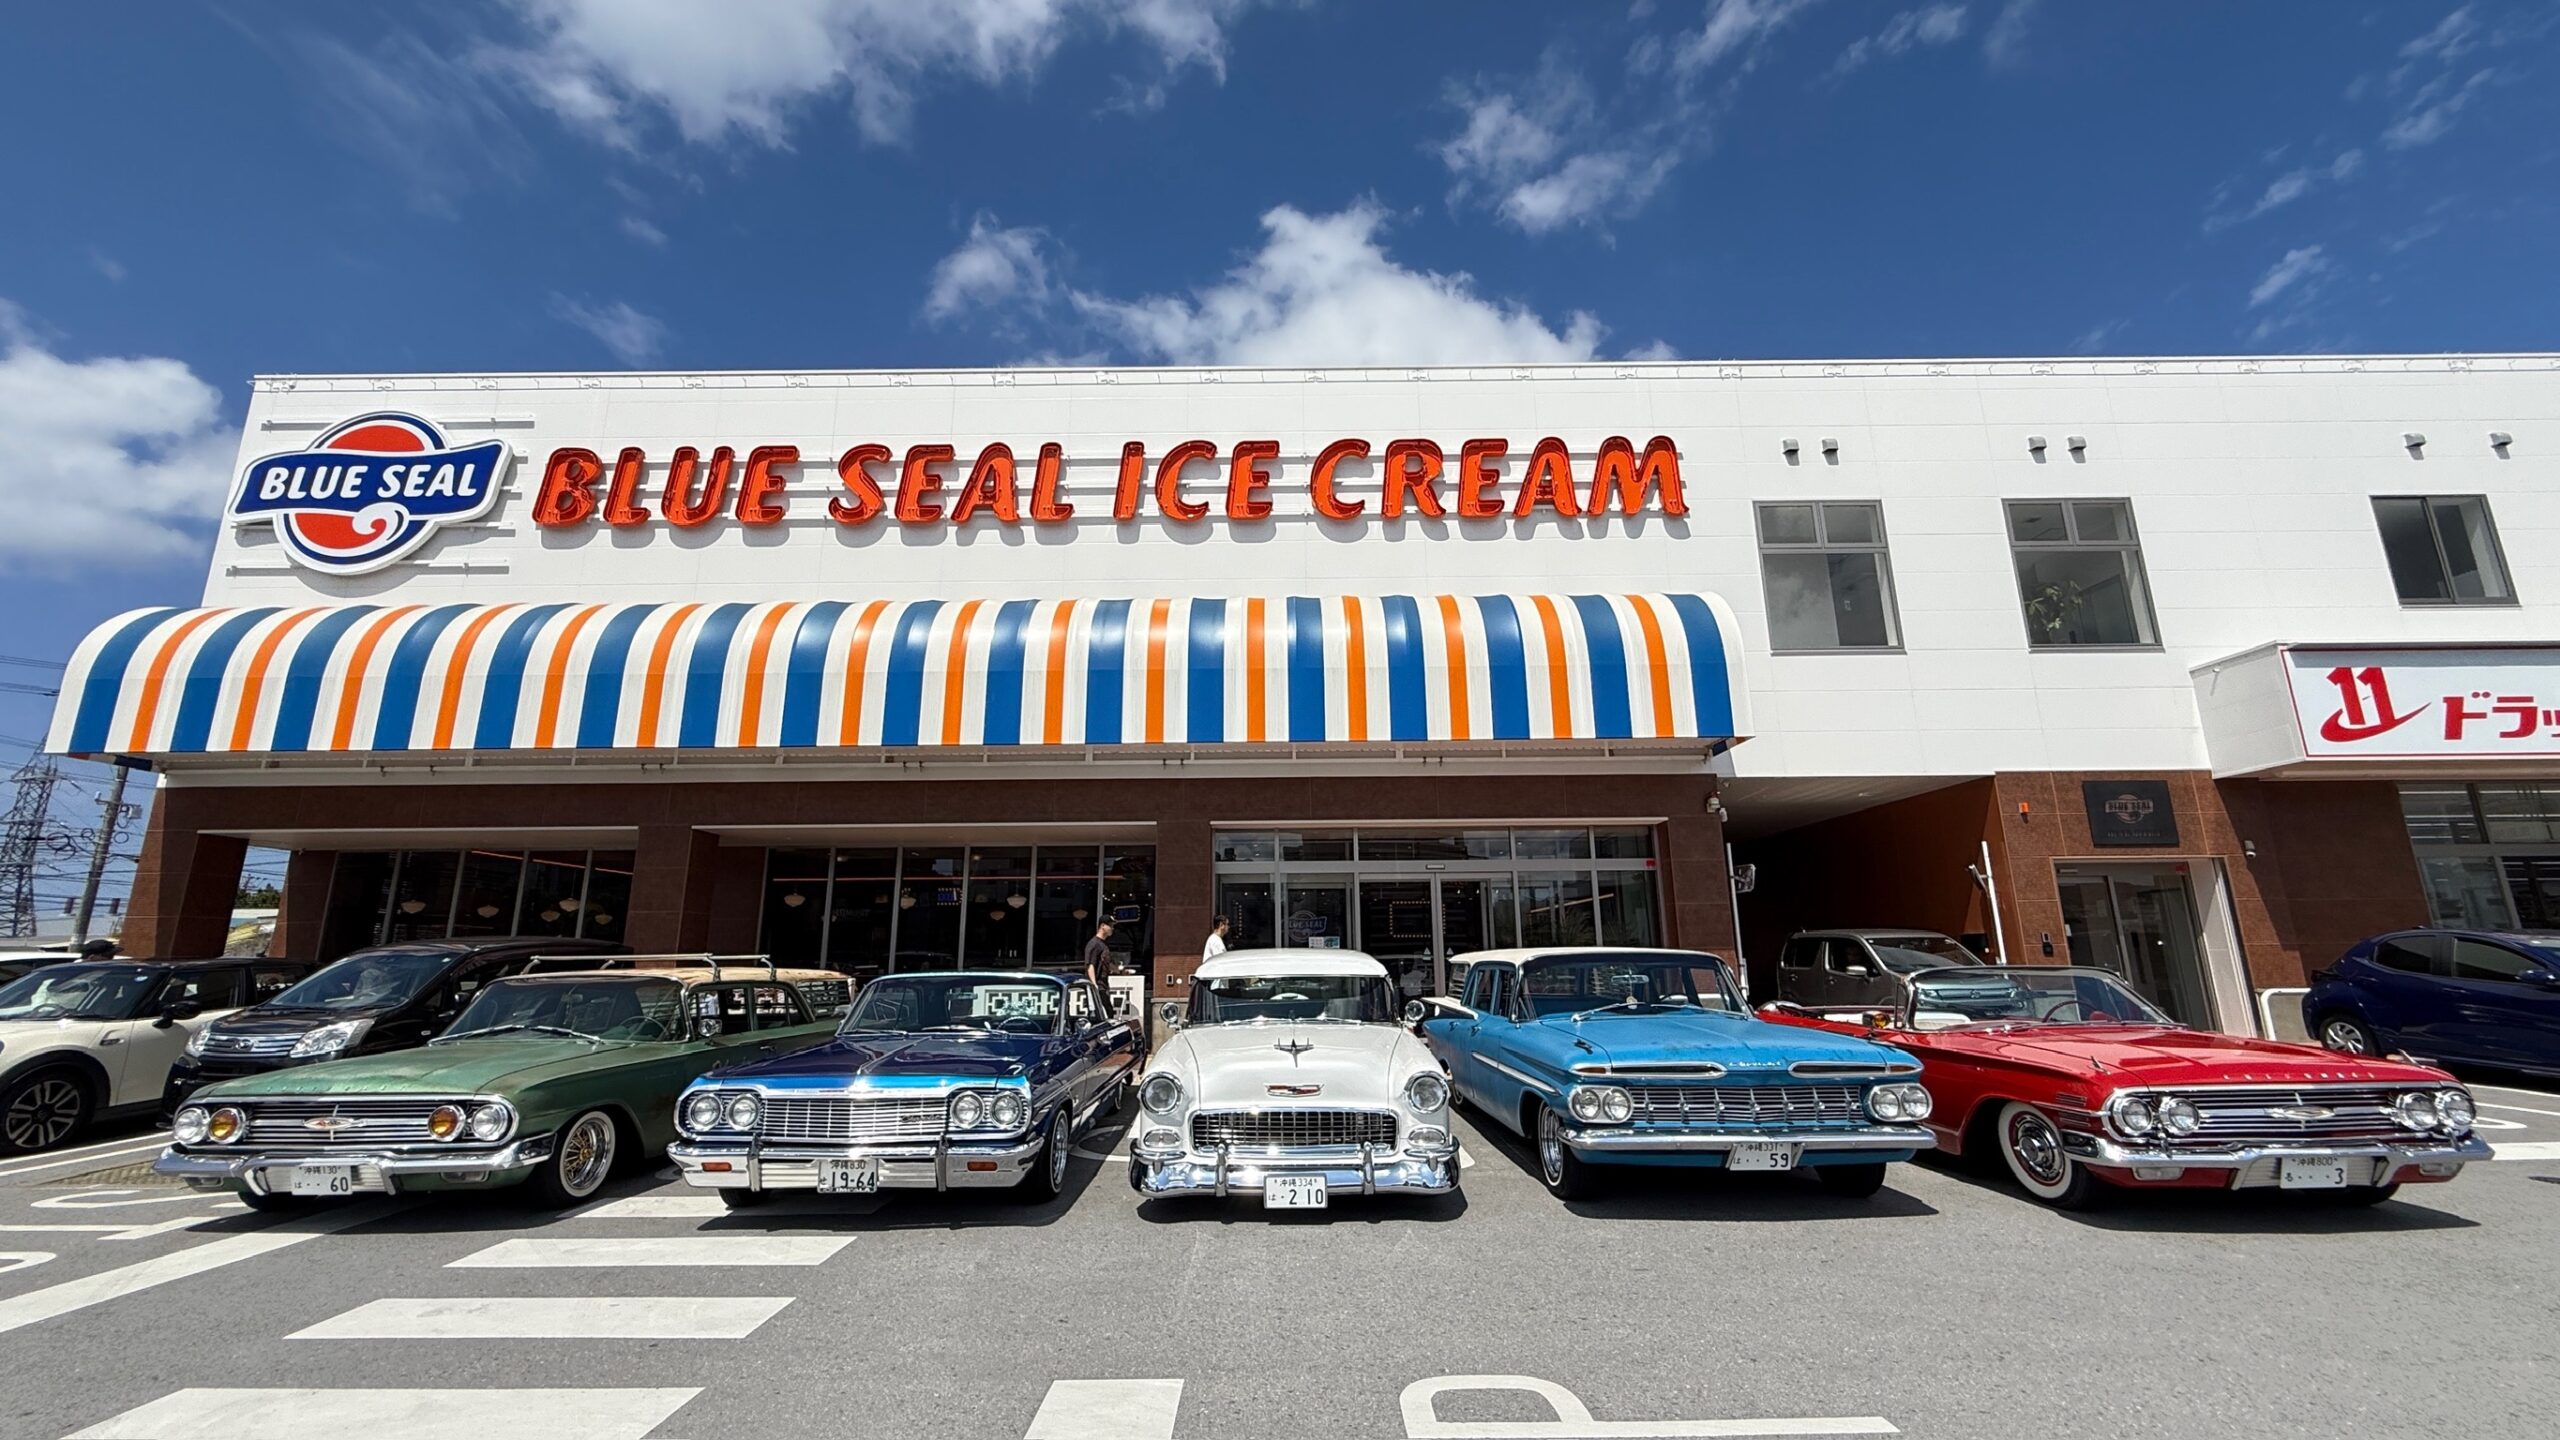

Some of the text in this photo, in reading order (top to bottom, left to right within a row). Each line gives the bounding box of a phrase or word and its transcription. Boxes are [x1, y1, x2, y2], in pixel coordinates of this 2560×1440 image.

[259, 463, 477, 500] BLUE SEAL
[532, 435, 1690, 526] BLUE SEAL ICE CREAM
[832, 1172, 875, 1189] 19-64
